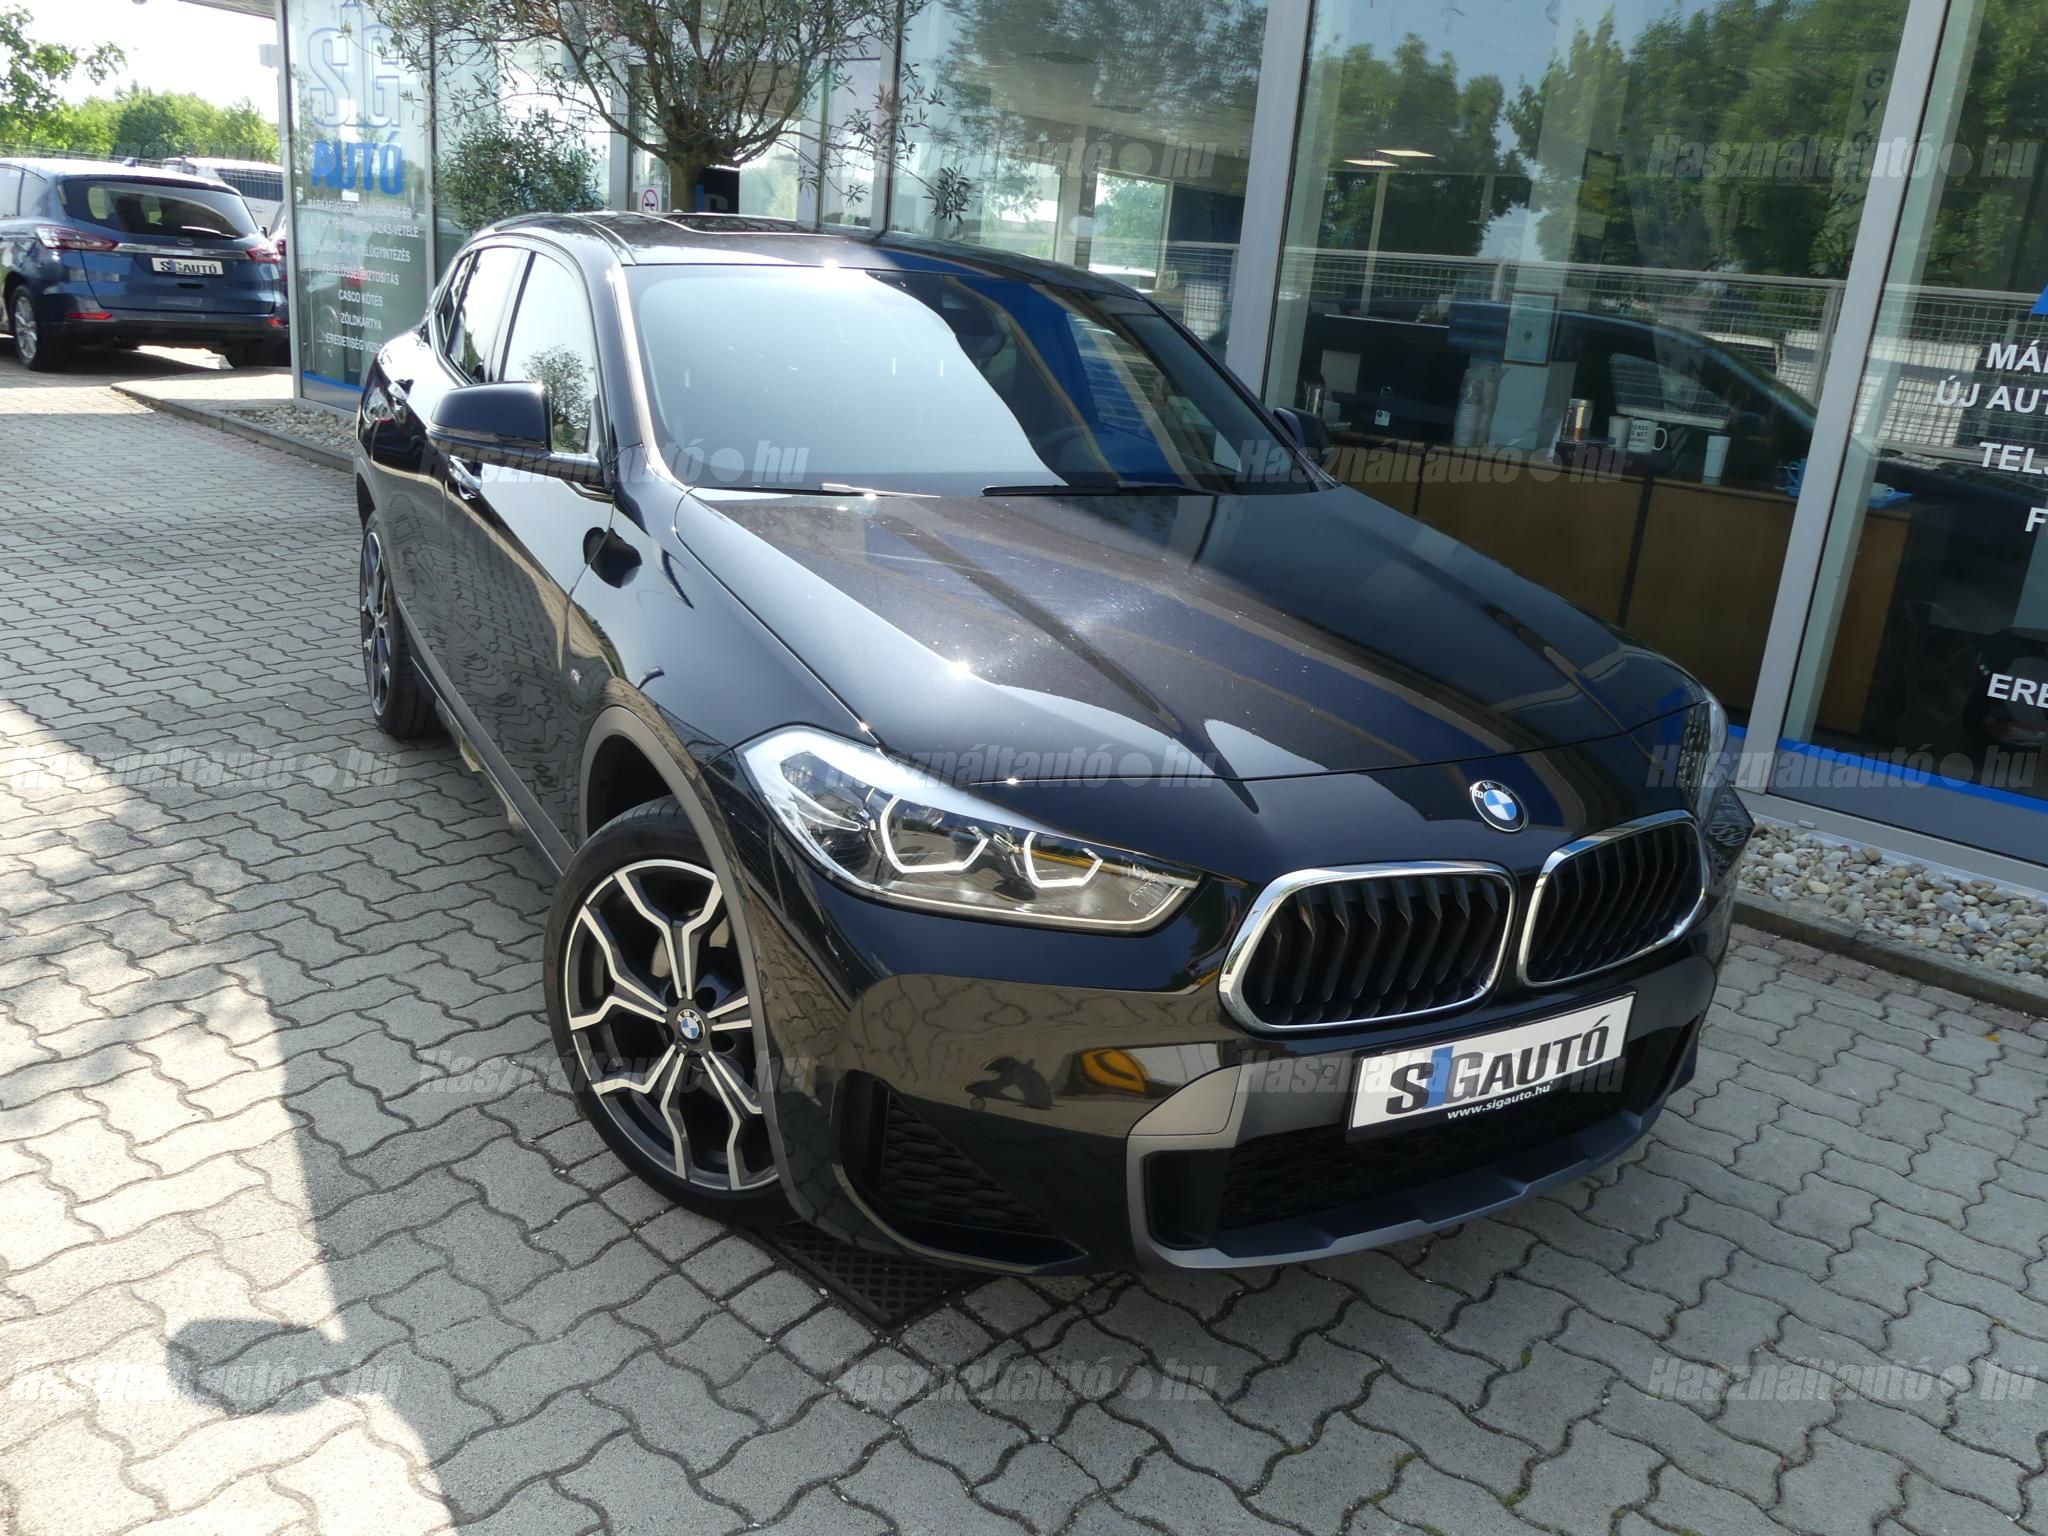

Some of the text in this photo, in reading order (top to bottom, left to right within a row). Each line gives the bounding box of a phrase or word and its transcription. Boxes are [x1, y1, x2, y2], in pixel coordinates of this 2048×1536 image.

[311, 131, 404, 195] AUTÓ
[338, 289, 360, 304] CASCO
[341, 311, 383, 331] ZÖLDKÁRTYA
[1937, 375, 1980, 408] ÚJ
[1980, 442, 2048, 475] TEL
[1447, 1084, 1551, 1120] www.sigauto.hu
